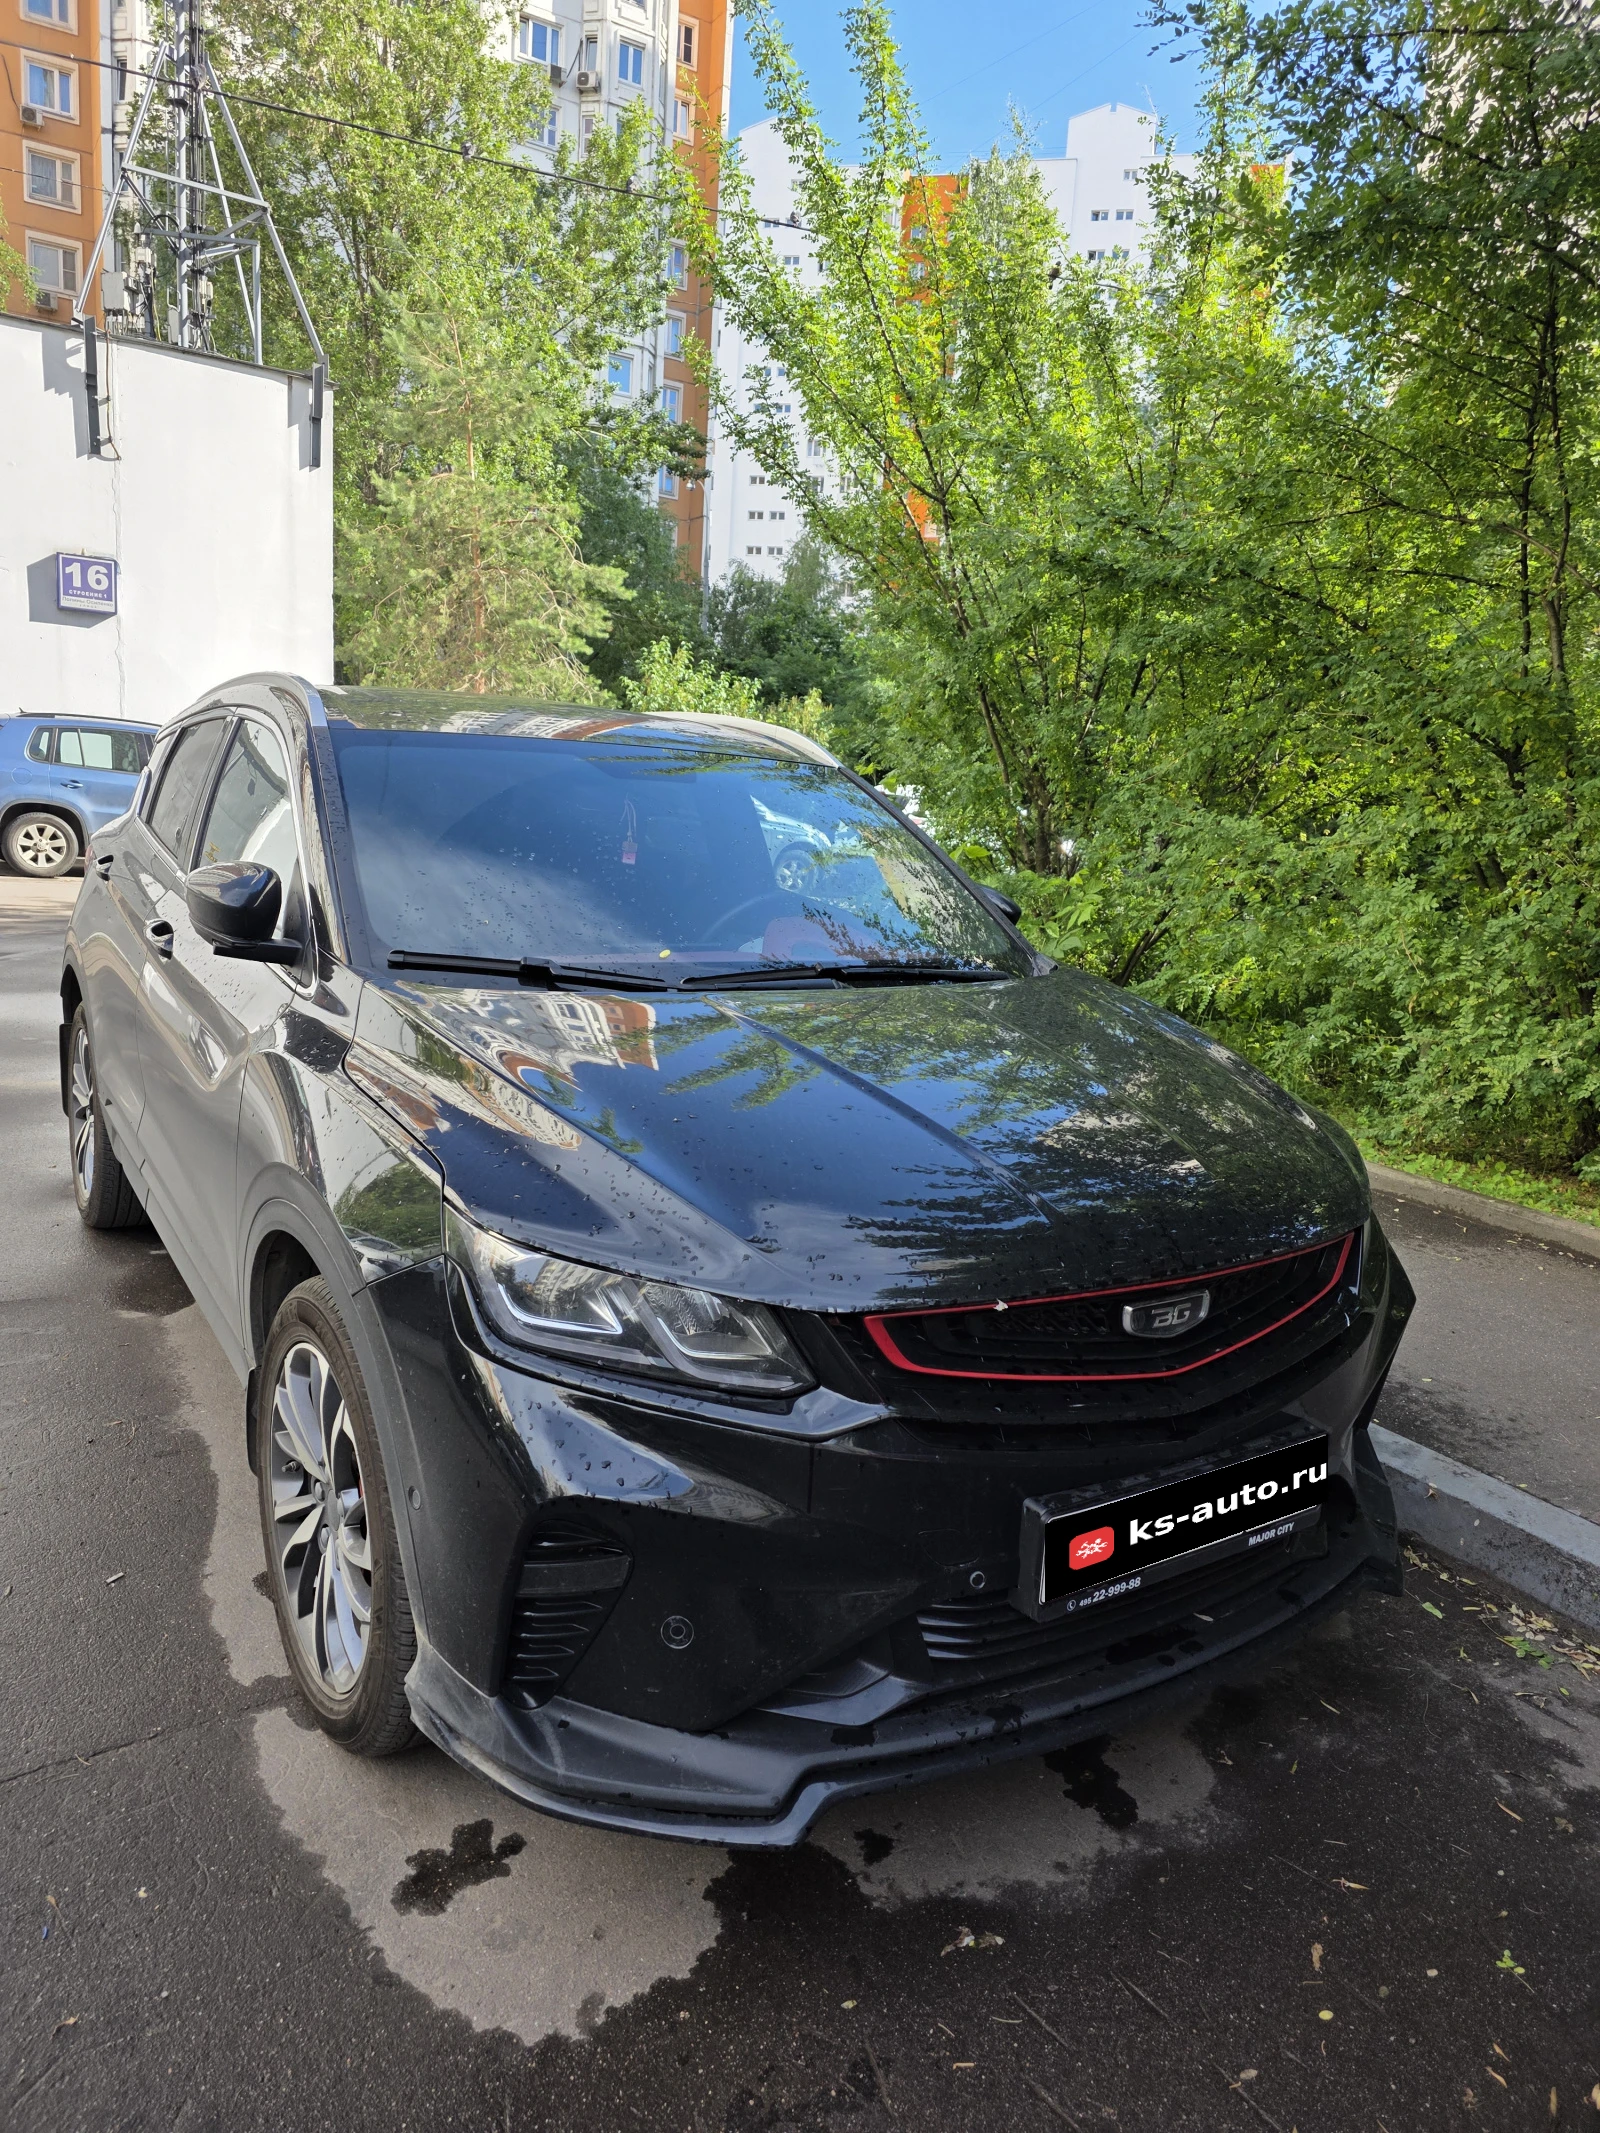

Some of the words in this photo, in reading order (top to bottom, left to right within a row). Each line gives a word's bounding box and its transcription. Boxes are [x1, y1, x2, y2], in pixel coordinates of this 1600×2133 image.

[65, 562, 109, 591] 16
[69, 589, 103, 598] СТРОЕНИЕ
[1248, 1528, 1276, 1547] MAJOR
[1276, 1521, 1295, 1536] CITY
[1079, 1597, 1092, 1607] 495
[1092, 1576, 1142, 1603] 22-999-88
